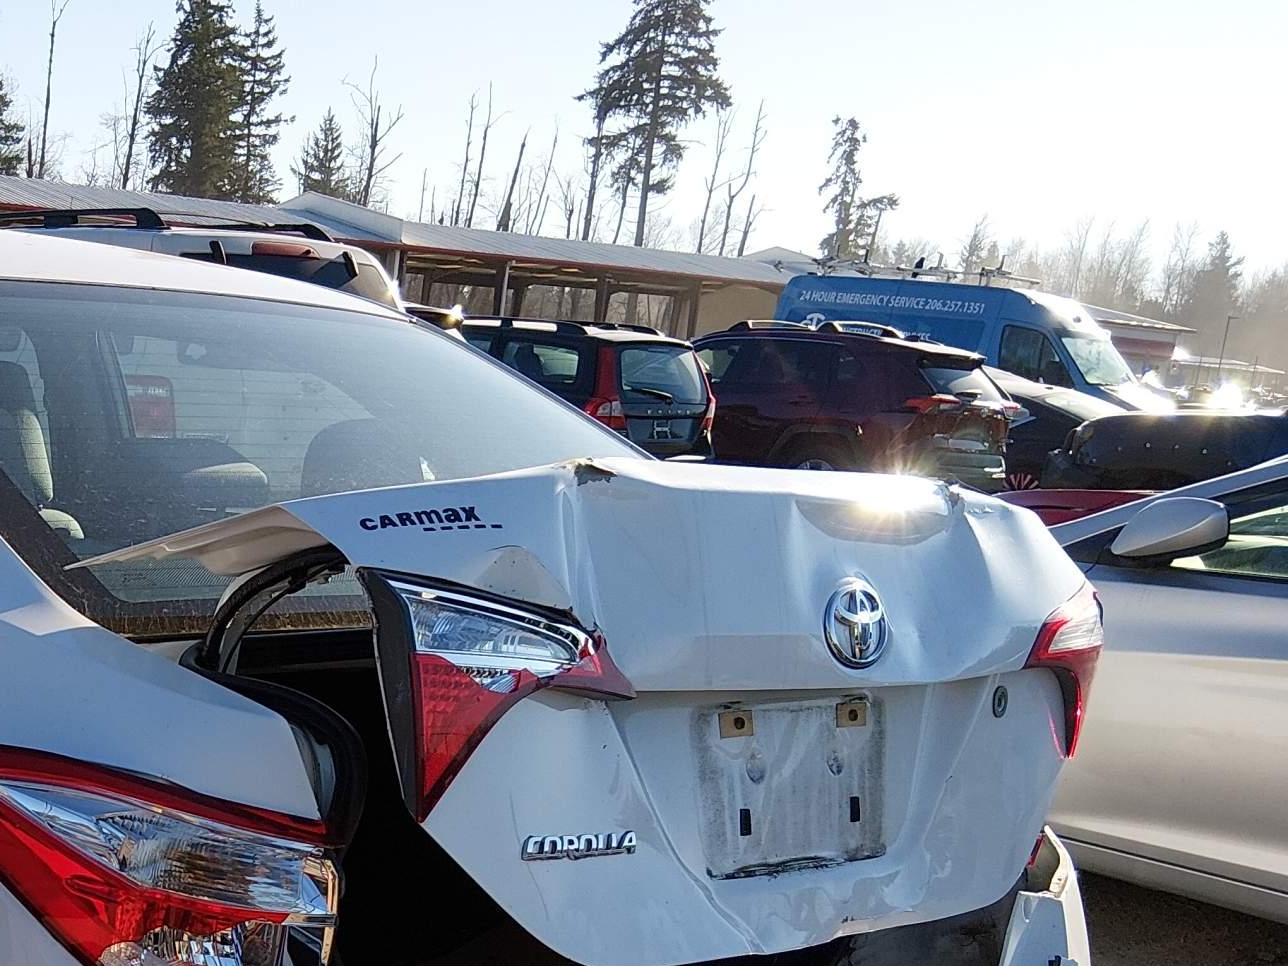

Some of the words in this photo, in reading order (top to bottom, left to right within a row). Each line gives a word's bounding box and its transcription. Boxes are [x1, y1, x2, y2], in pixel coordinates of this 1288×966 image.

[800, 291, 811, 301] 24
[812, 291, 836, 302] HOUR
[836, 293, 889, 307] EMERGENCY
[888, 296, 926, 309] SERVICE
[925, 299, 985, 314] 206.257.1351
